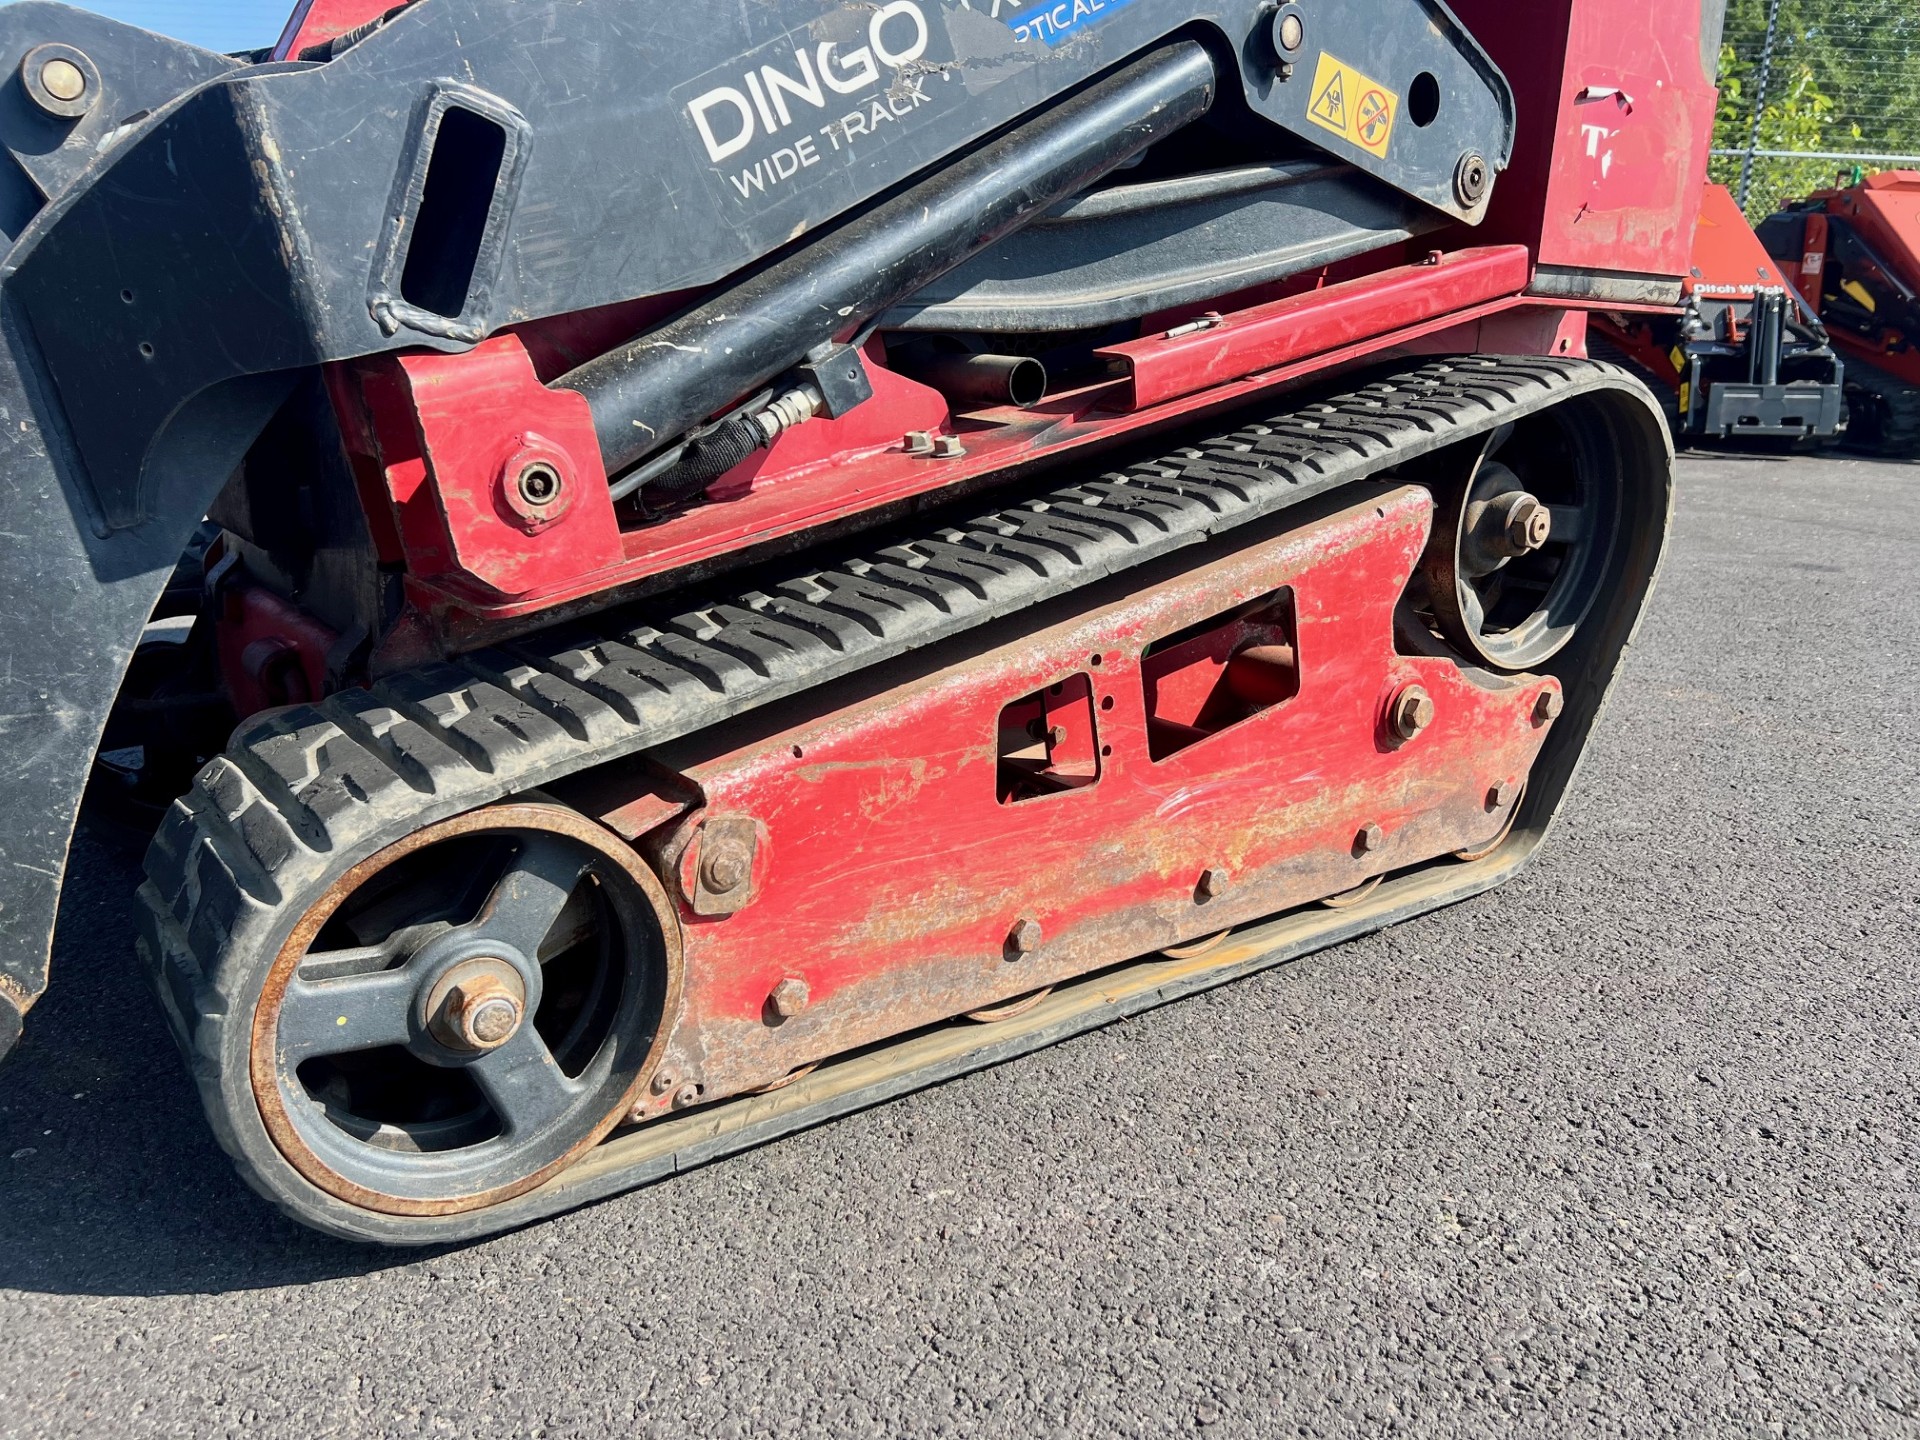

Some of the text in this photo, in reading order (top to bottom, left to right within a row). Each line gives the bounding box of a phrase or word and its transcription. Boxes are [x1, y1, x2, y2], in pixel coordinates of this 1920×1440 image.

[687, 0, 928, 163] DINGO
[729, 76, 932, 199] WIDE TRACK
[1693, 283, 1736, 294] Ditch
